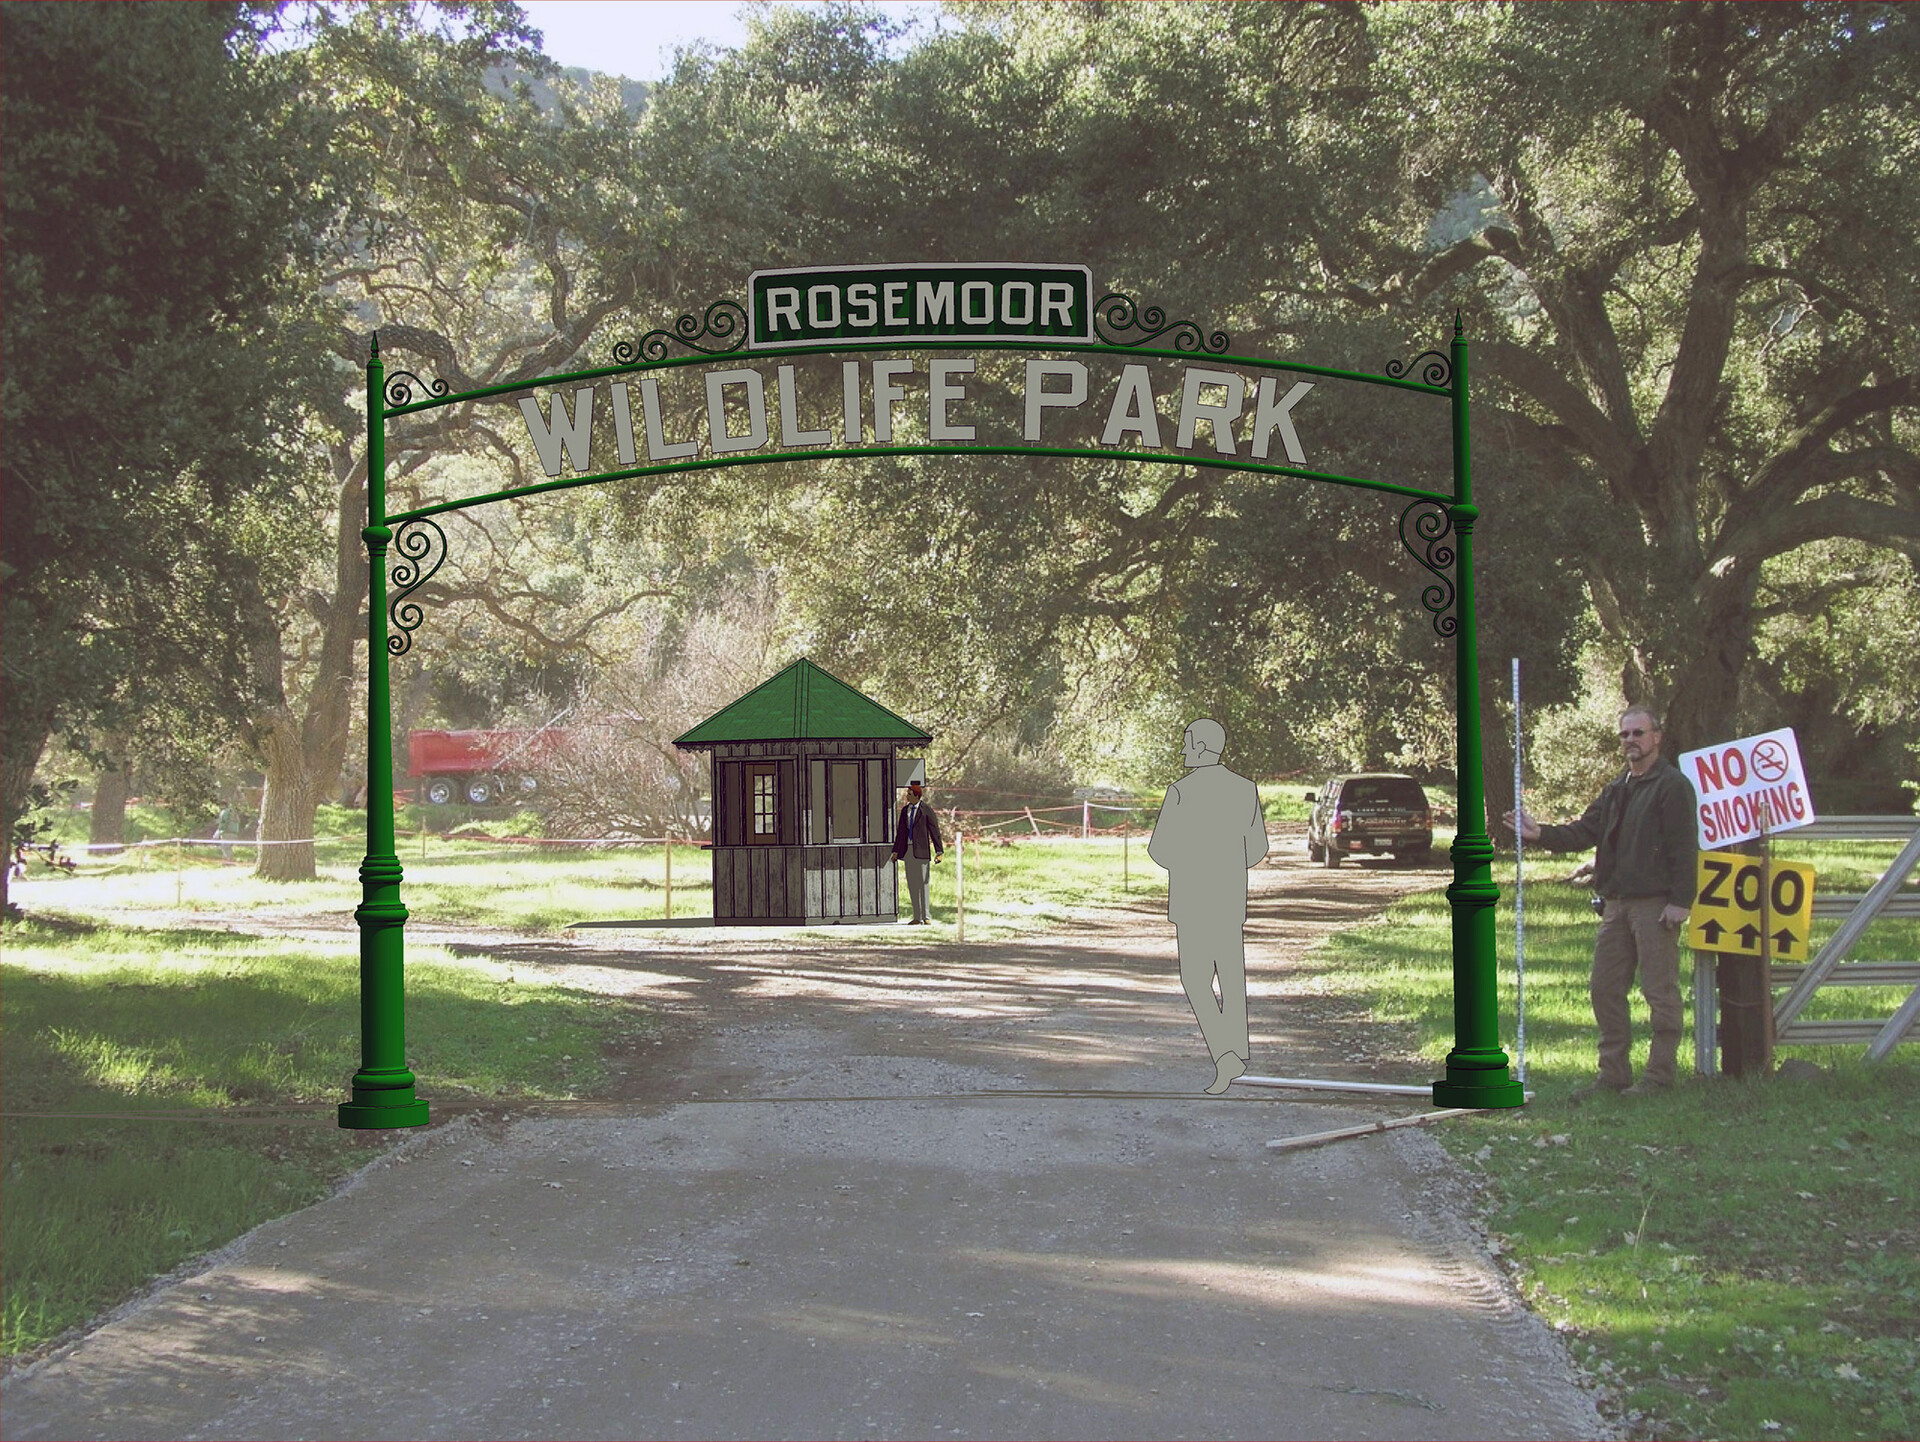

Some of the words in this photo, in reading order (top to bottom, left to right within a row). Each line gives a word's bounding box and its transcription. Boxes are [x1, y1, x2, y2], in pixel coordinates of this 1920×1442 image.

[766, 280, 1075, 332] ROSEMOOR
[517, 359, 977, 477] WILDLIFE
[1023, 359, 1316, 465] PARK
[1695, 747, 1748, 794] NO
[1700, 782, 1806, 842] SMOKING
[1698, 860, 1805, 916] ZOO
